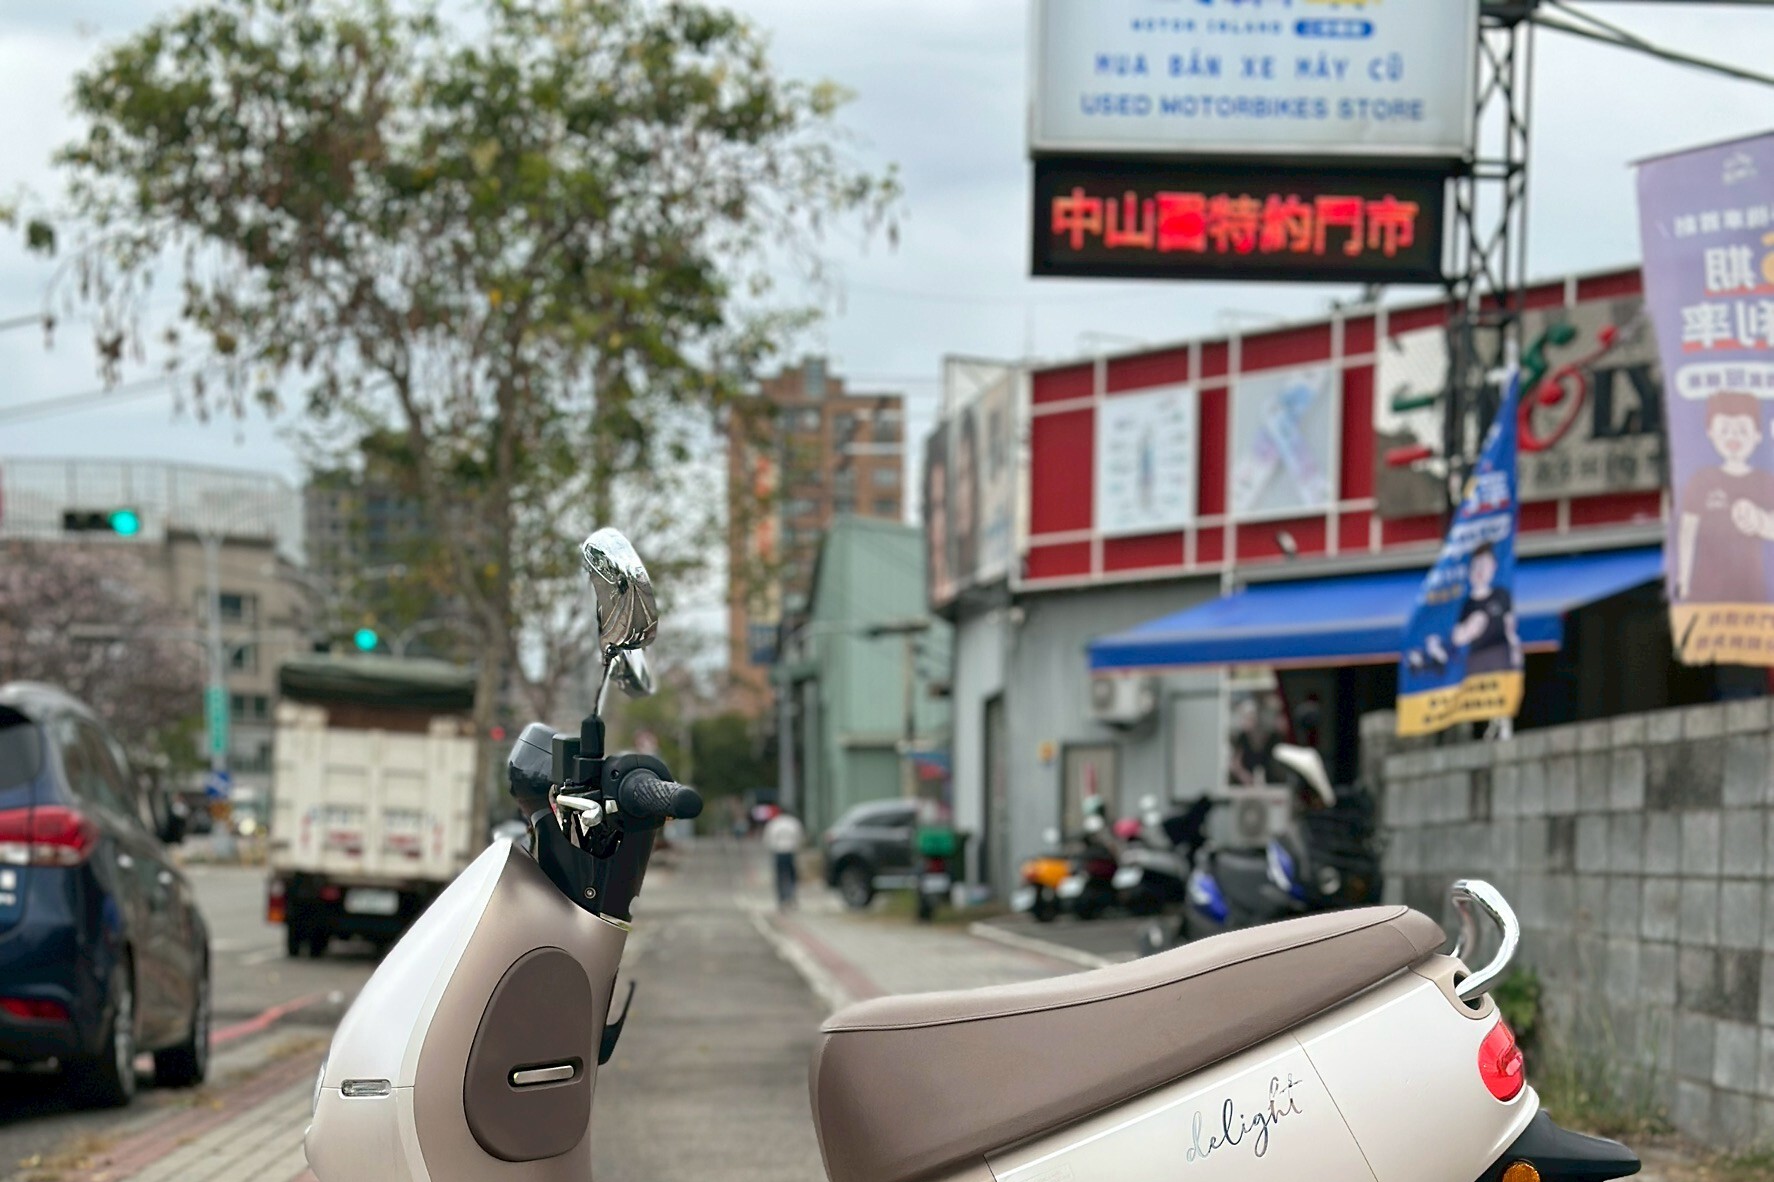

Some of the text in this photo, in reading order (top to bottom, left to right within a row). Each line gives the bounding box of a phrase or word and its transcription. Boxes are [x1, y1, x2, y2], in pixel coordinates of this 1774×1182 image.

[1241, 55, 1275, 79] XE
[1080, 93, 1425, 121] USED MOTORBIKES STORE
[1186, 1073, 1303, 1162] delight
